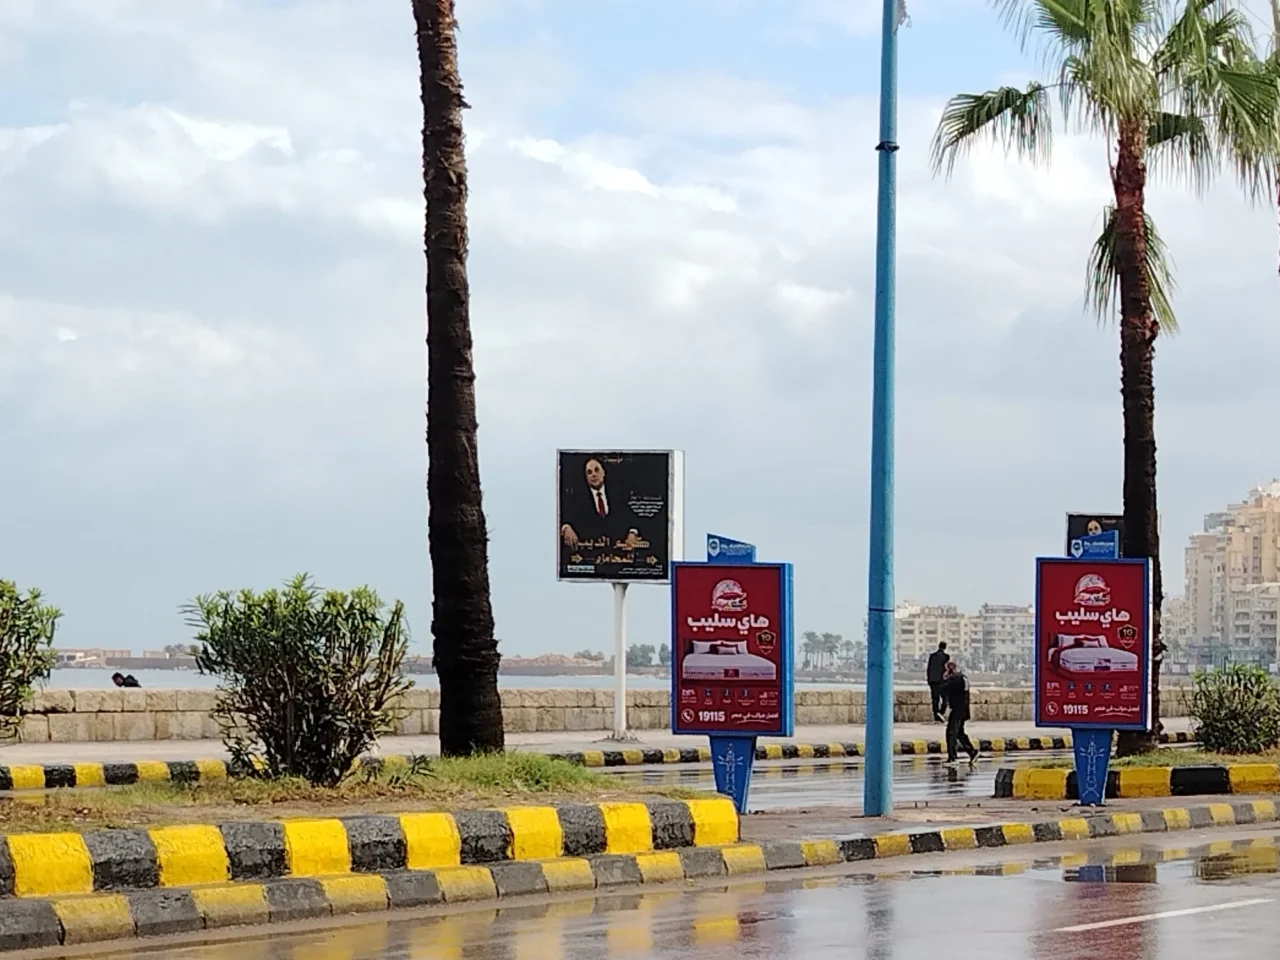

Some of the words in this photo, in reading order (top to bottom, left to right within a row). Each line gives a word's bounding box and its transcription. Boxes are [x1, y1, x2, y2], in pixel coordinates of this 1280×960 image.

[687, 613, 736, 632] سليب
[737, 613, 769, 635] هاي
[1055, 607, 1099, 625] سليب
[1100, 608, 1130, 628] هاي
[699, 711, 725, 722] 19115
